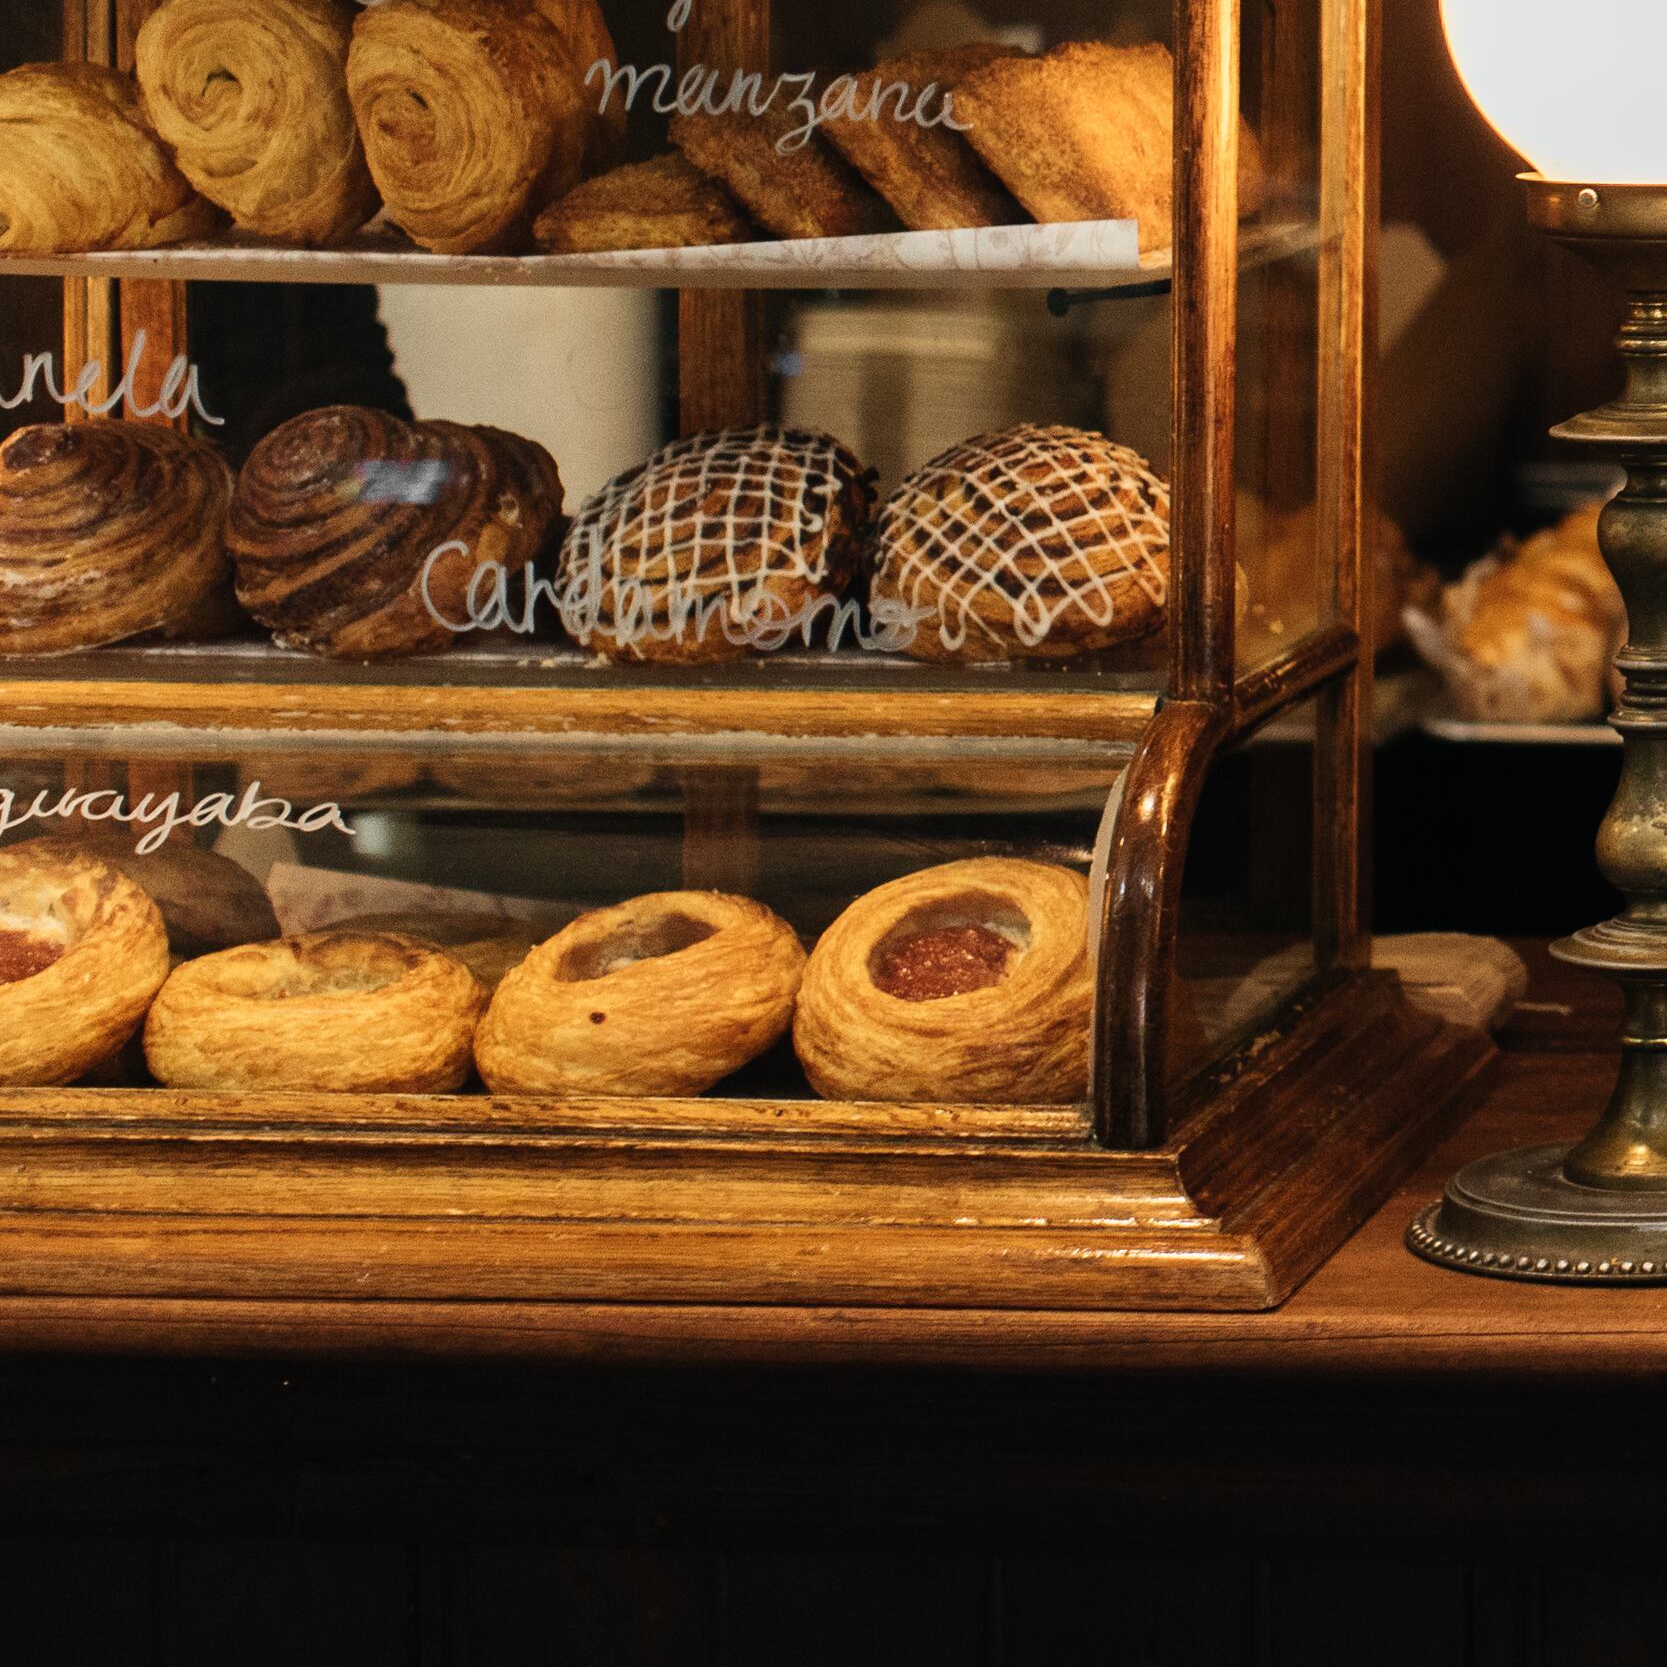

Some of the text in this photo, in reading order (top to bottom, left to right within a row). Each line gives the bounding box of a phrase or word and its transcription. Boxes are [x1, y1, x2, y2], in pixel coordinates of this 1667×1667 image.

[583, 58, 976, 156] manzana
[0, 328, 226, 427] nela
[420, 522, 941, 652] Cardamomo
